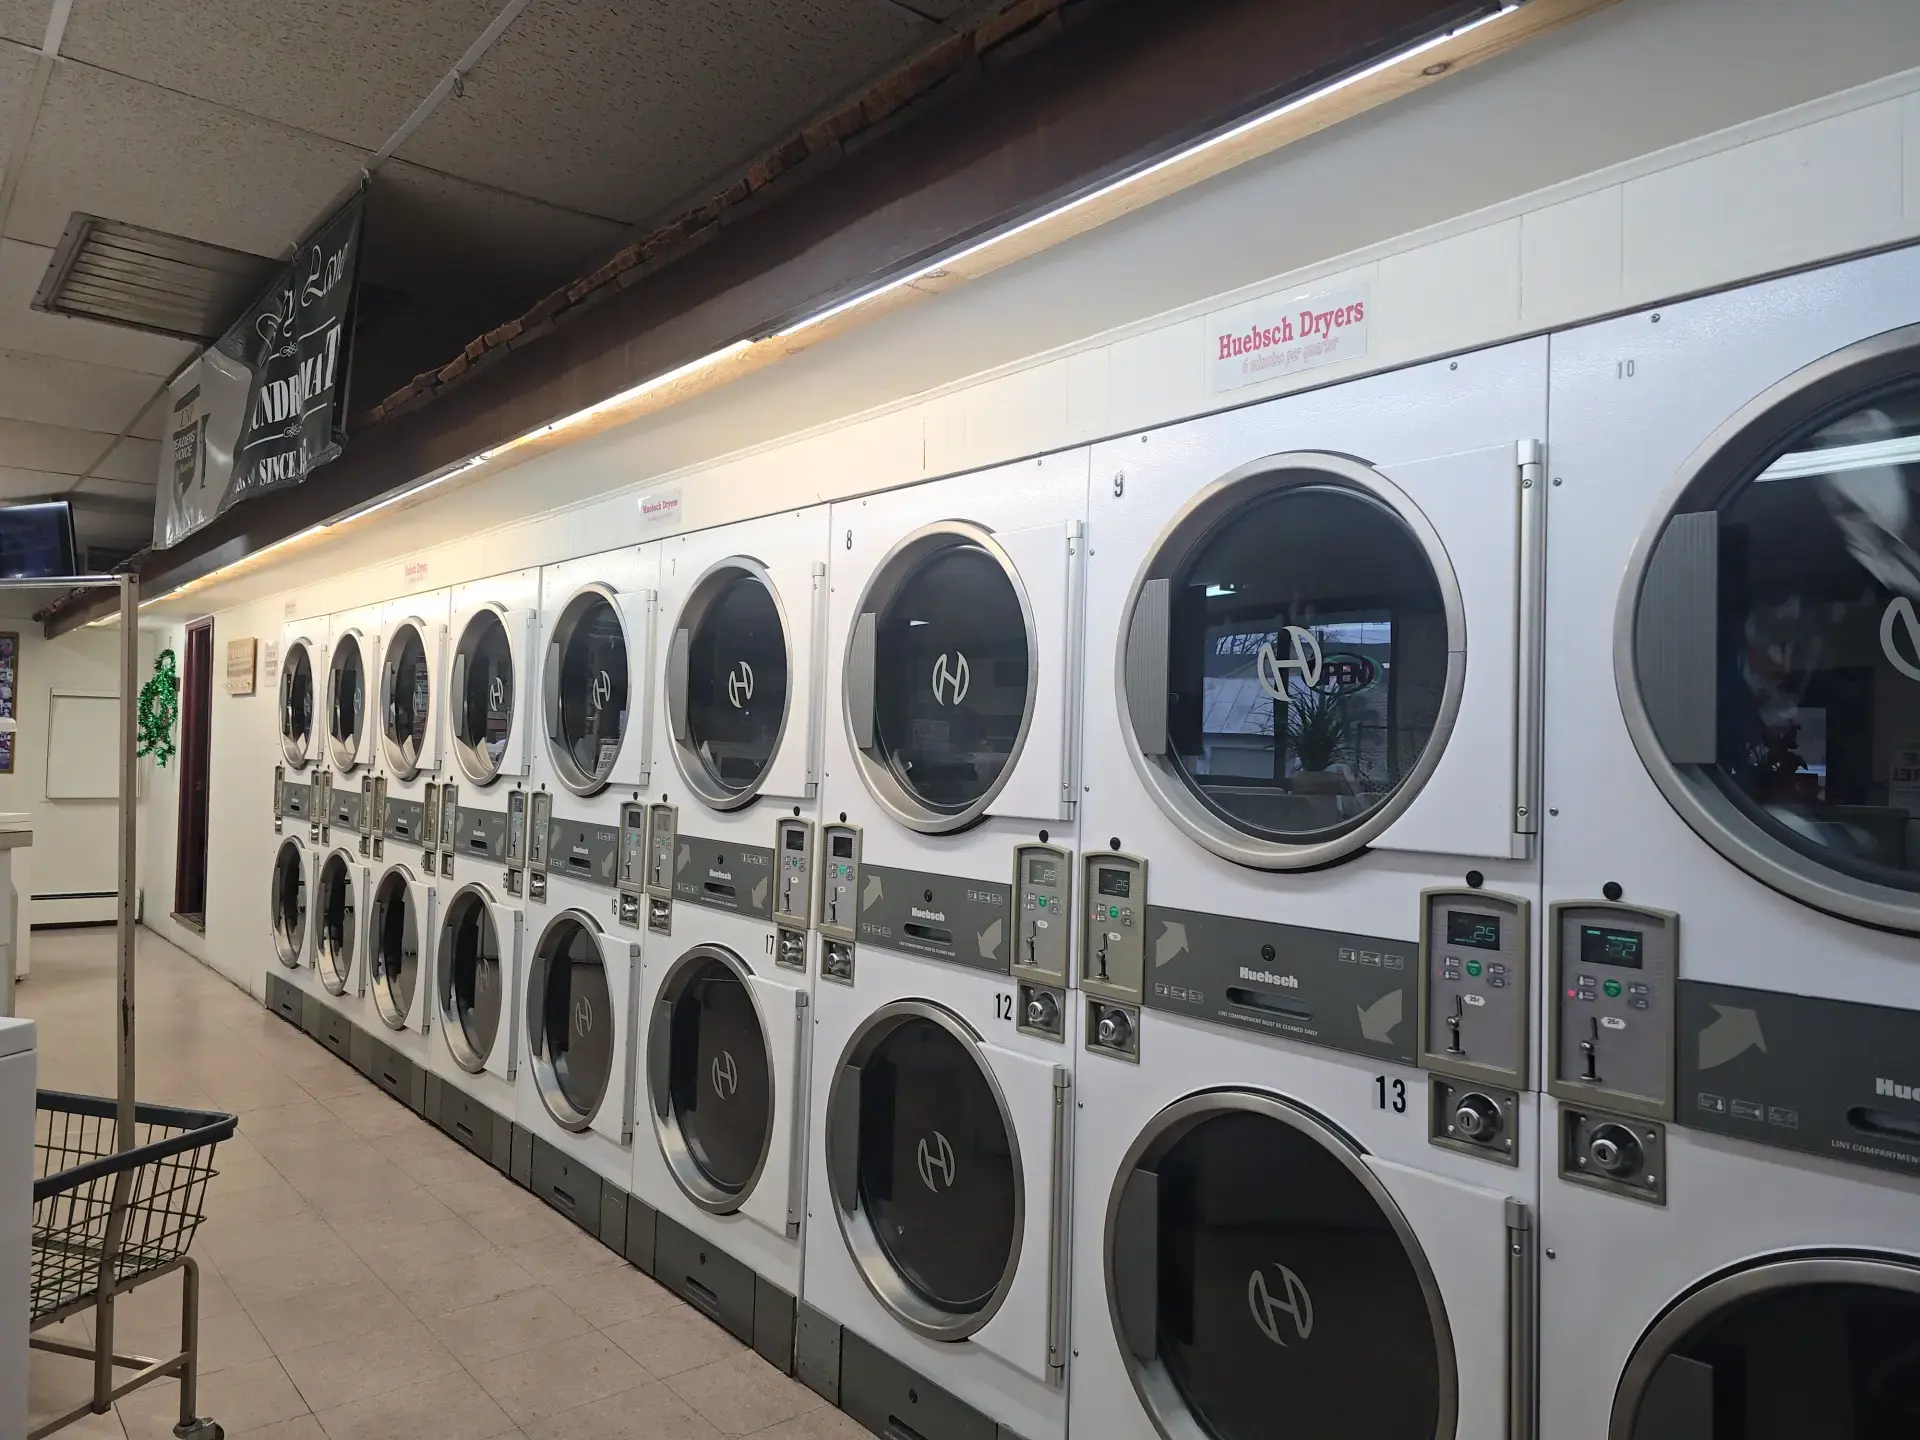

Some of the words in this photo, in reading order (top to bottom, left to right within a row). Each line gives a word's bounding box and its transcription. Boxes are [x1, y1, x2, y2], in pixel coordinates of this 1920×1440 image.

[1218, 316, 1293, 360] Huebsch
[1299, 300, 1364, 339] Dryers
[1617, 359, 1635, 380] 10
[259, 450, 297, 486] SINCE
[846, 529, 853, 550] 8
[611, 898, 618, 915] 16
[911, 907, 945, 922] Huebsch
[766, 934, 775, 955] 17
[1239, 966, 1299, 989] Huebsch
[995, 993, 1012, 1021] 12
[1376, 1075, 1407, 1114] 13
[1831, 1139, 1851, 1150] LINT
[1852, 1143, 1920, 1164] COMPARTMEN
